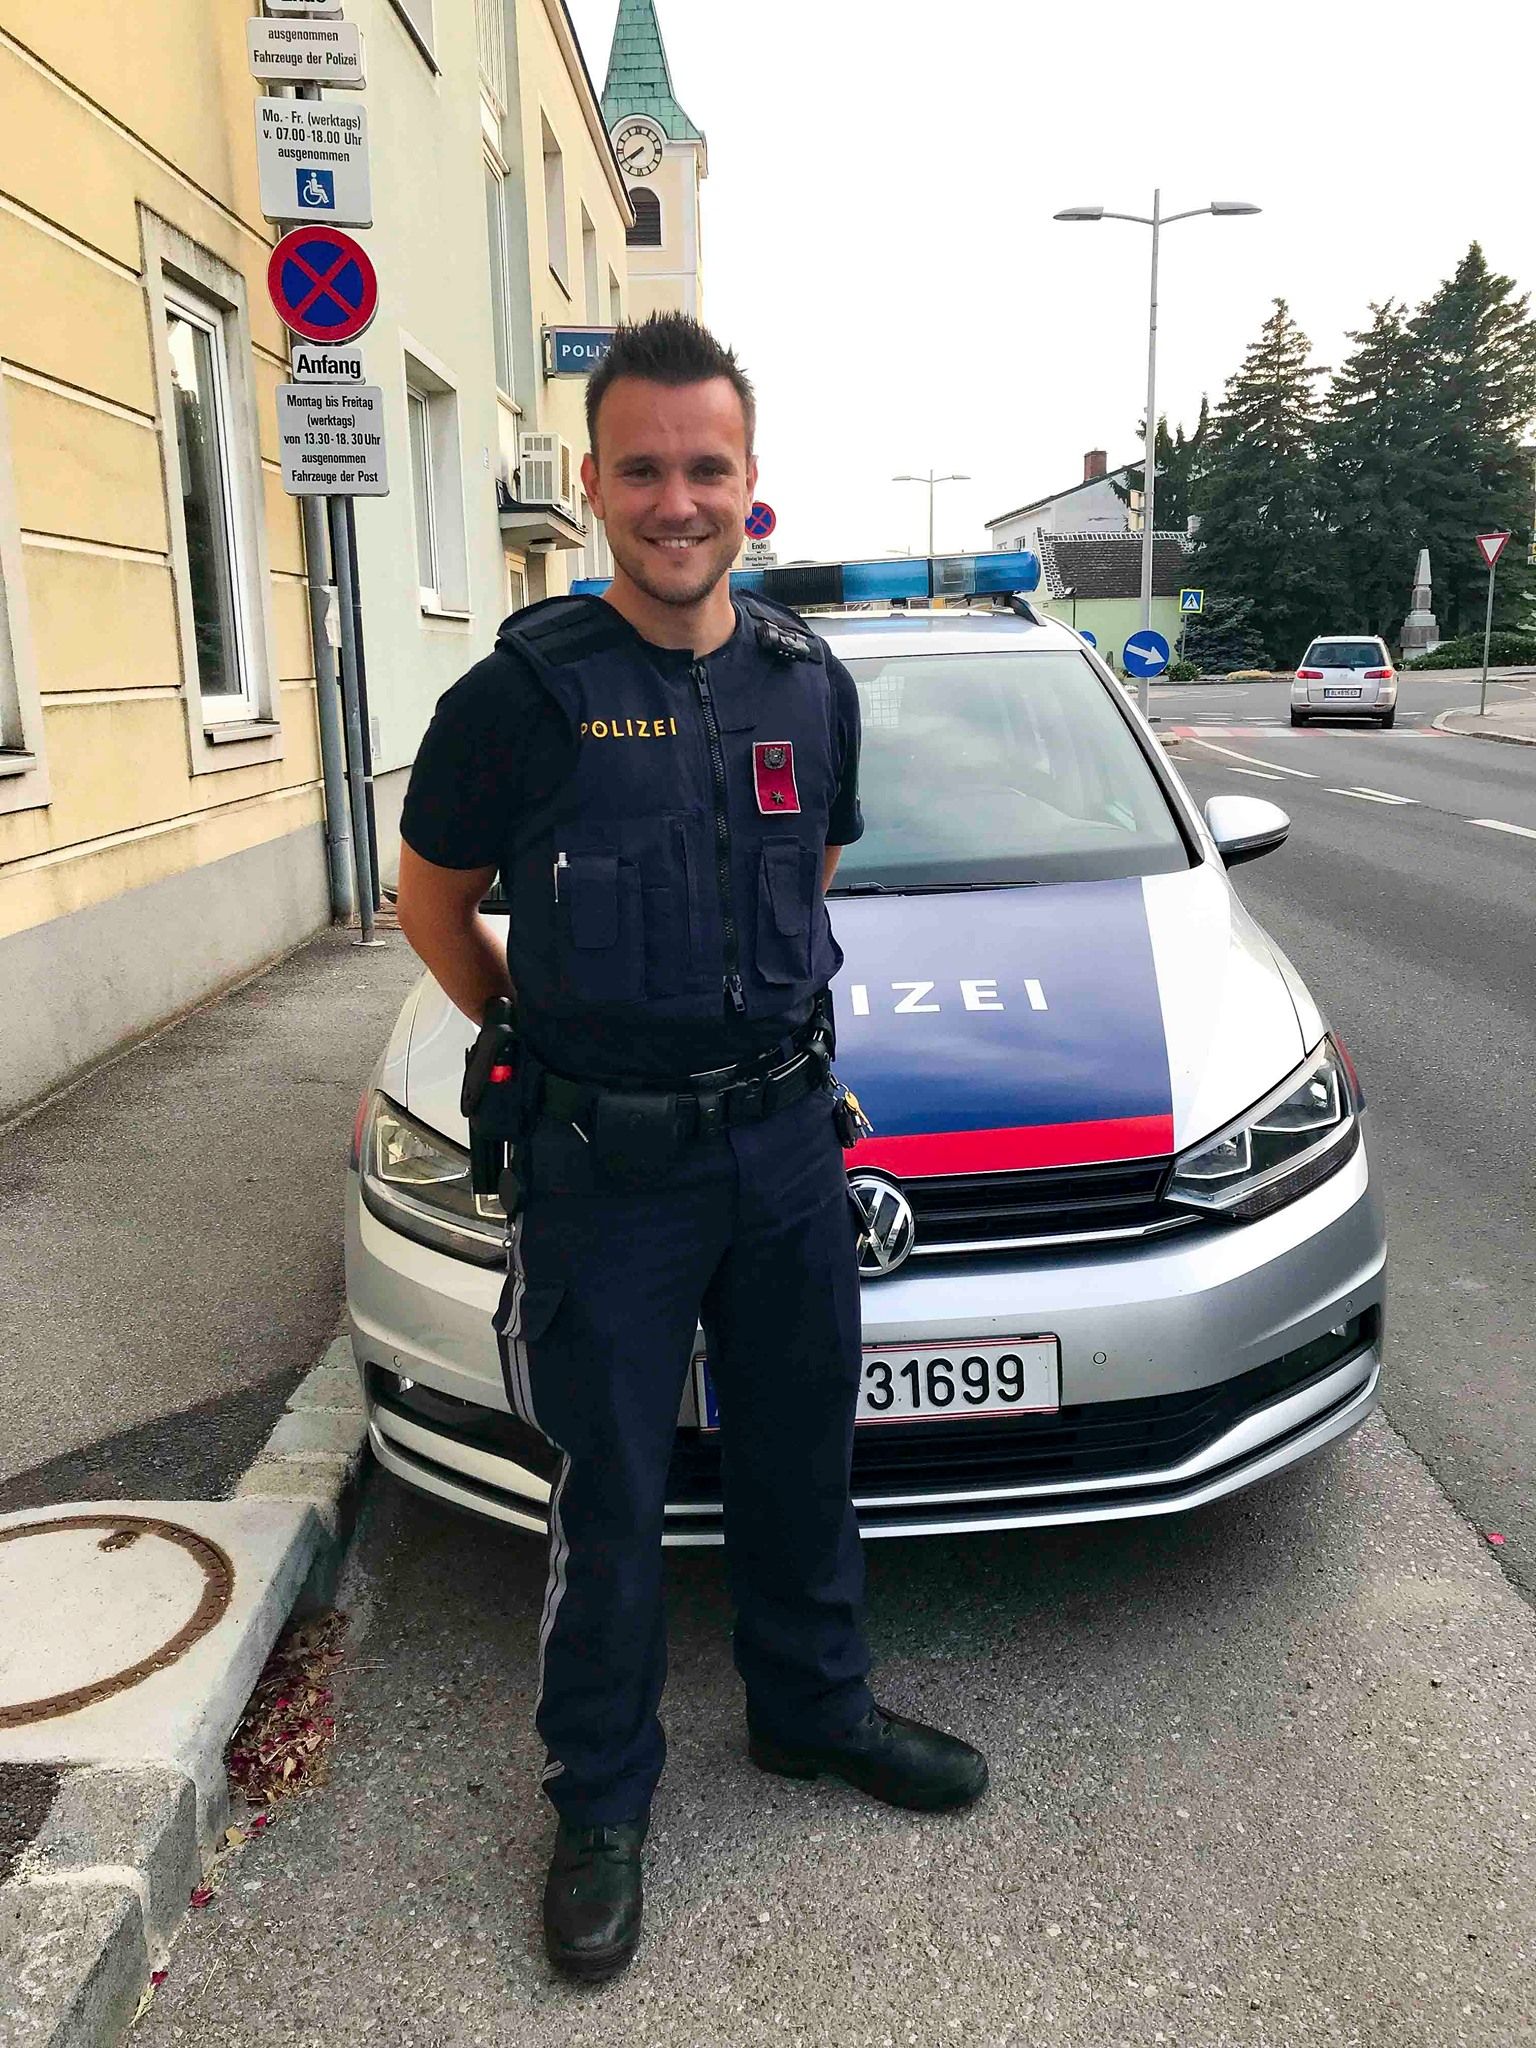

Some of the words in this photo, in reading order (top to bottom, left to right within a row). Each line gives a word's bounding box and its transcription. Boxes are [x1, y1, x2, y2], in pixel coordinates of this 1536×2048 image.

[268, 28, 339, 43] ausgenommen
[254, 49, 303, 66] Fahrzeuge
[306, 51, 322, 65] der
[326, 52, 357, 66] Polizei
[307, 112, 361, 130] (werktags)
[263, 130, 272, 140] v.
[344, 132, 362, 146] Uhr
[278, 147, 350, 162] ausgenommen
[562, 344, 611, 358] POLIZ
[297, 354, 361, 378] Anfang
[287, 394, 322, 409] Montag
[325, 395, 339, 407] bis
[342, 396, 373, 410] Freitag
[307, 414, 356, 429] (werktags)
[284, 434, 300, 445] von
[365, 433, 381, 445] Uhr
[301, 453, 366, 466] ausgenommen
[292, 470, 337, 484] Fahrzeuge
[340, 470, 355, 482] der
[358, 470, 378, 482] Post
[581, 717, 678, 739] POLIZEI
[851, 979, 1049, 1016] IZEI
[866, 1353, 1025, 1410] 31699
